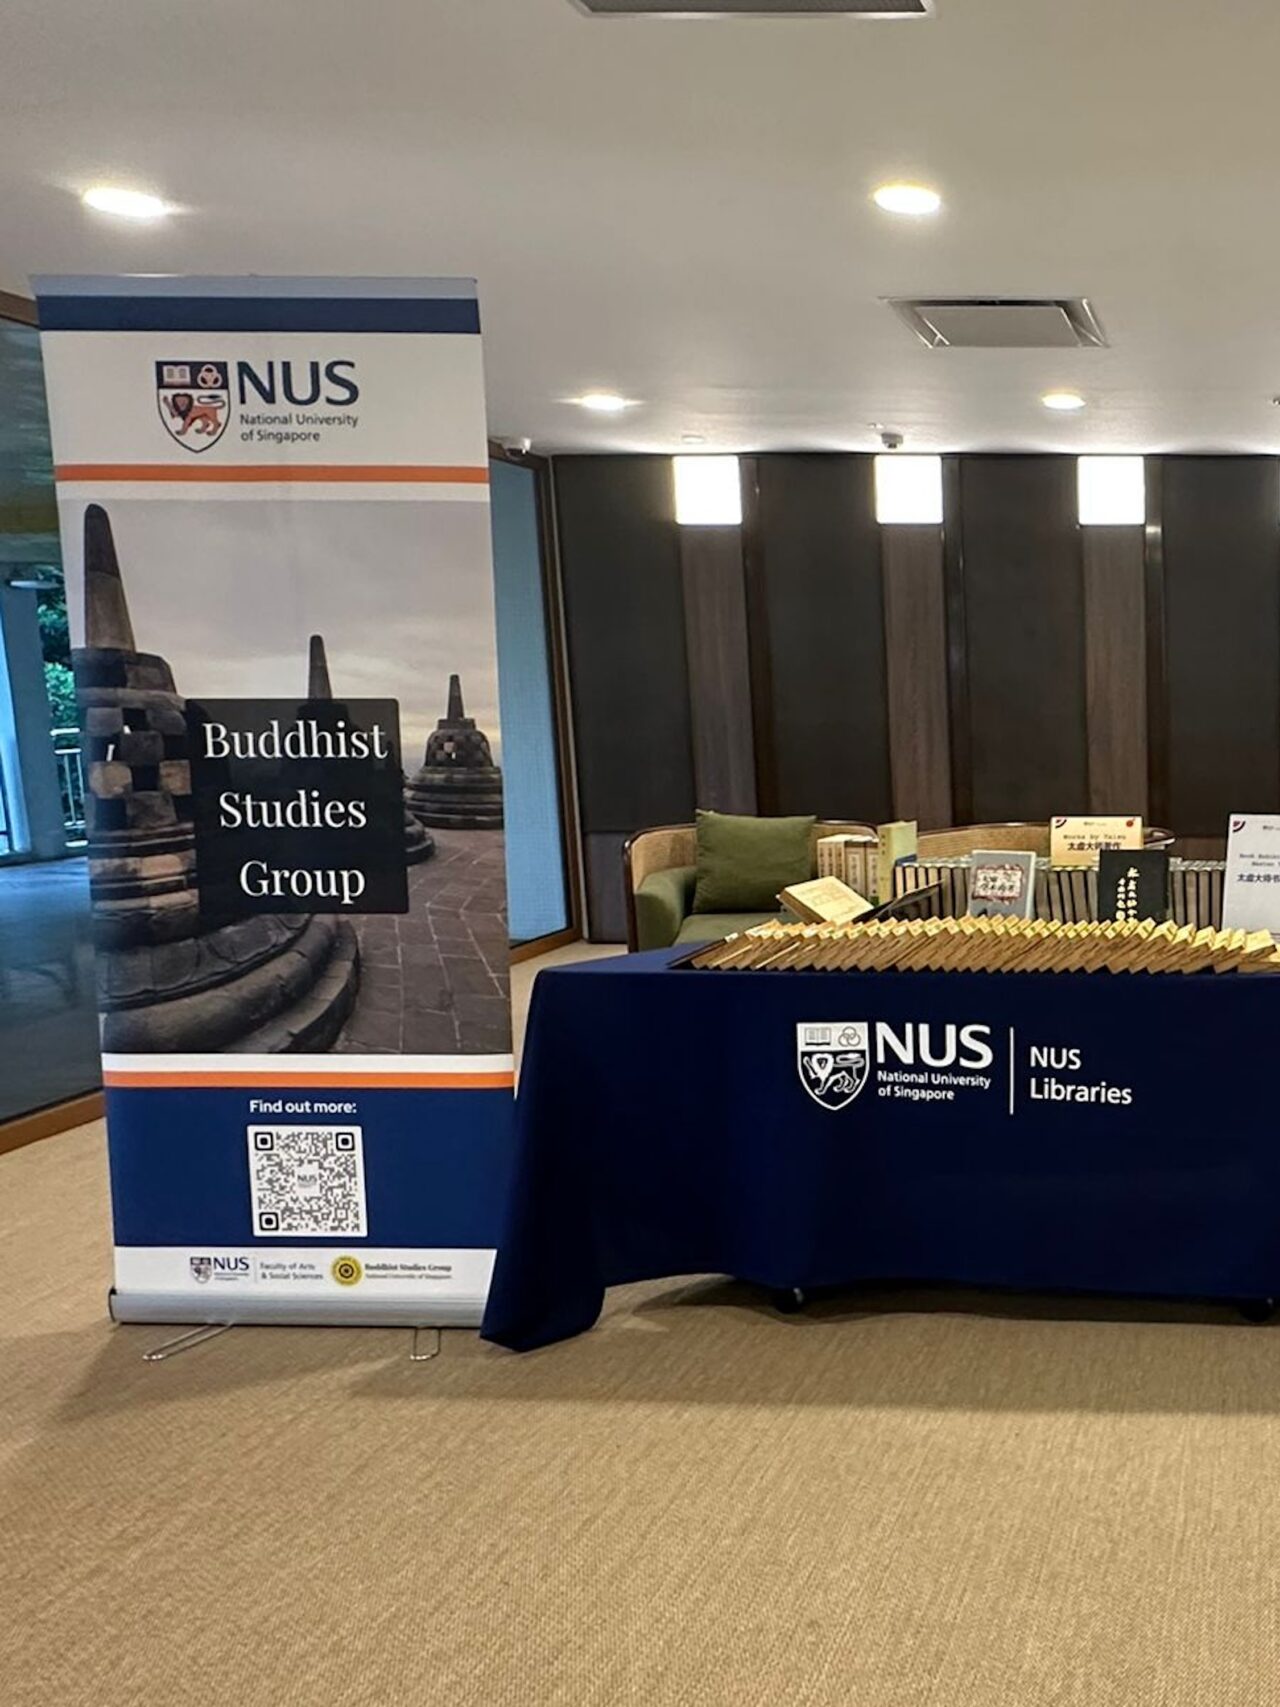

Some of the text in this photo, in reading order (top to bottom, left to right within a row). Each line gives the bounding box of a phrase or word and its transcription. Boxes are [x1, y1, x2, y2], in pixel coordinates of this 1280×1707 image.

[236, 360, 359, 406] NUS
[240, 413, 359, 428] National University
[240, 428, 321, 444] of Singapore
[203, 719, 389, 760] Buddhist
[219, 789, 367, 829] Studies
[239, 860, 366, 904] Group
[875, 1021, 994, 1069] NUS
[1030, 1046, 1081, 1070] NUS
[876, 1070, 992, 1089] National University
[1030, 1078, 1133, 1105] Libraries
[878, 1085, 955, 1101] of Singapore
[249, 1099, 357, 1114] Find out more:
[213, 1256, 250, 1271] NUS
